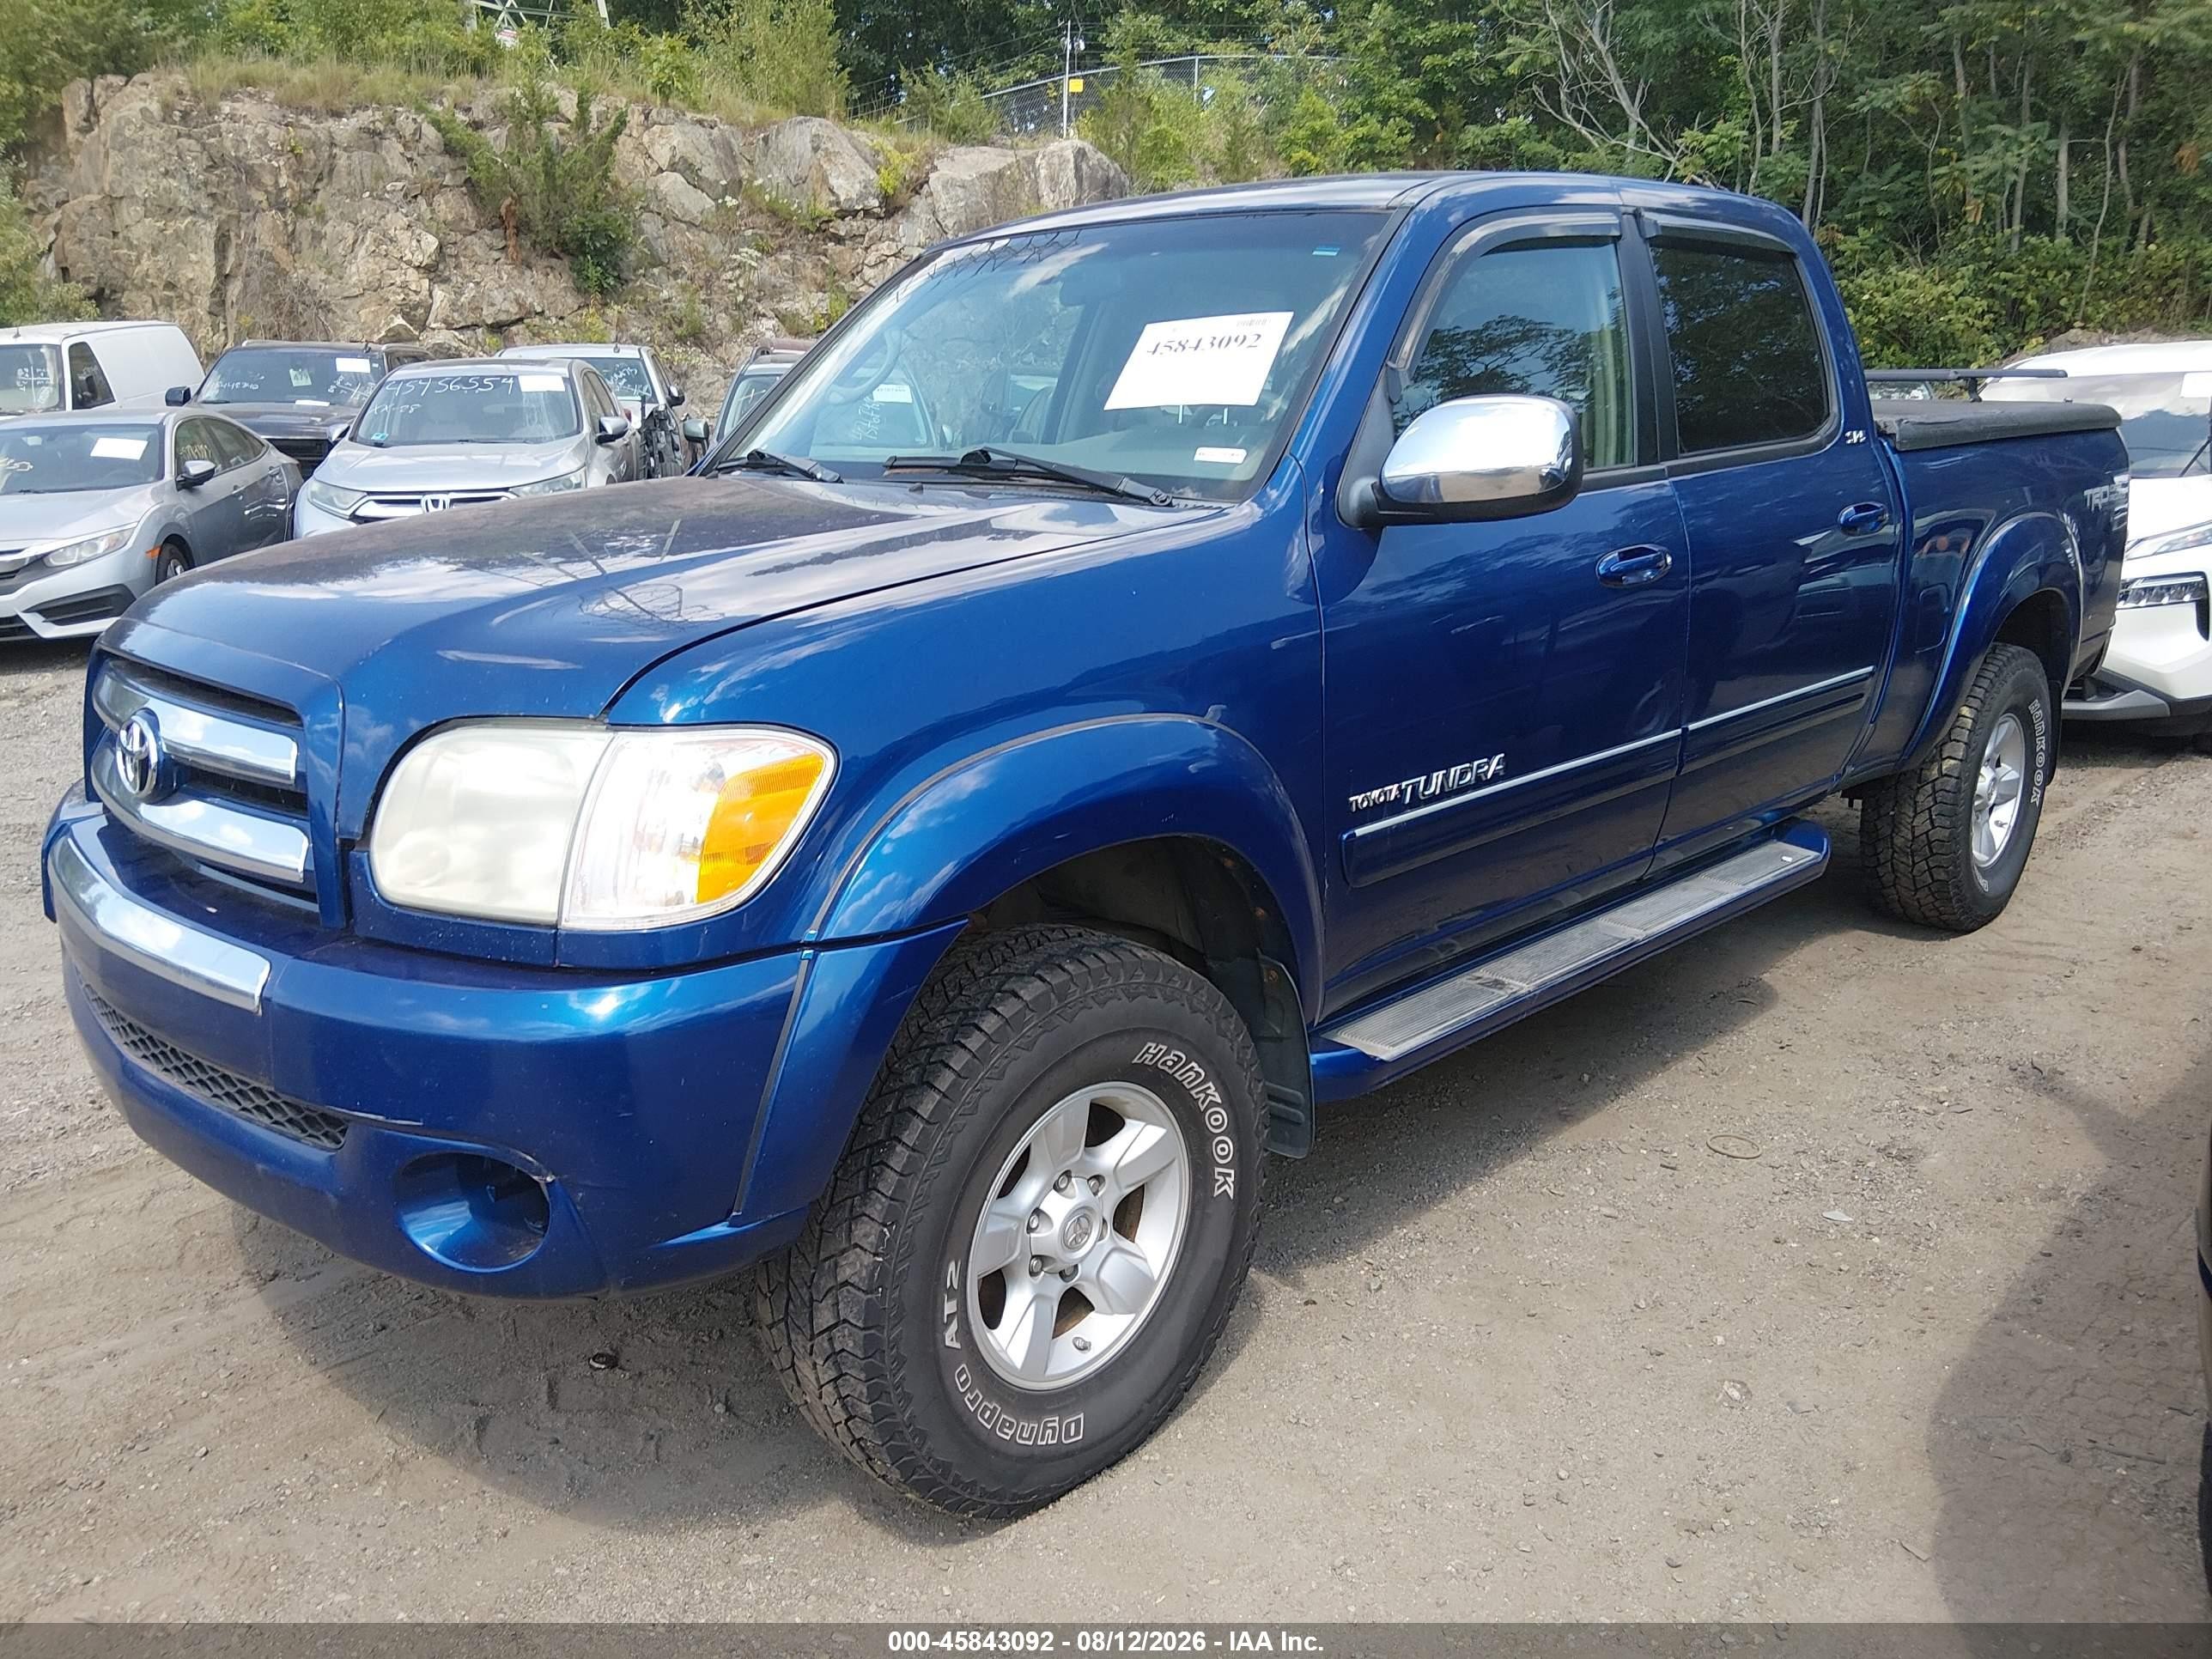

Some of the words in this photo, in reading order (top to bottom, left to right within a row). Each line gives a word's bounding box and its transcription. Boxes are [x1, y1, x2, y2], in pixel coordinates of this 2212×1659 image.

[1146, 333, 1262, 356] 45843092
[1349, 783, 1401, 812] TOYOTA
[1401, 752, 1507, 805] TUNDRA
[954, 1363, 1085, 1445] Dynapro
